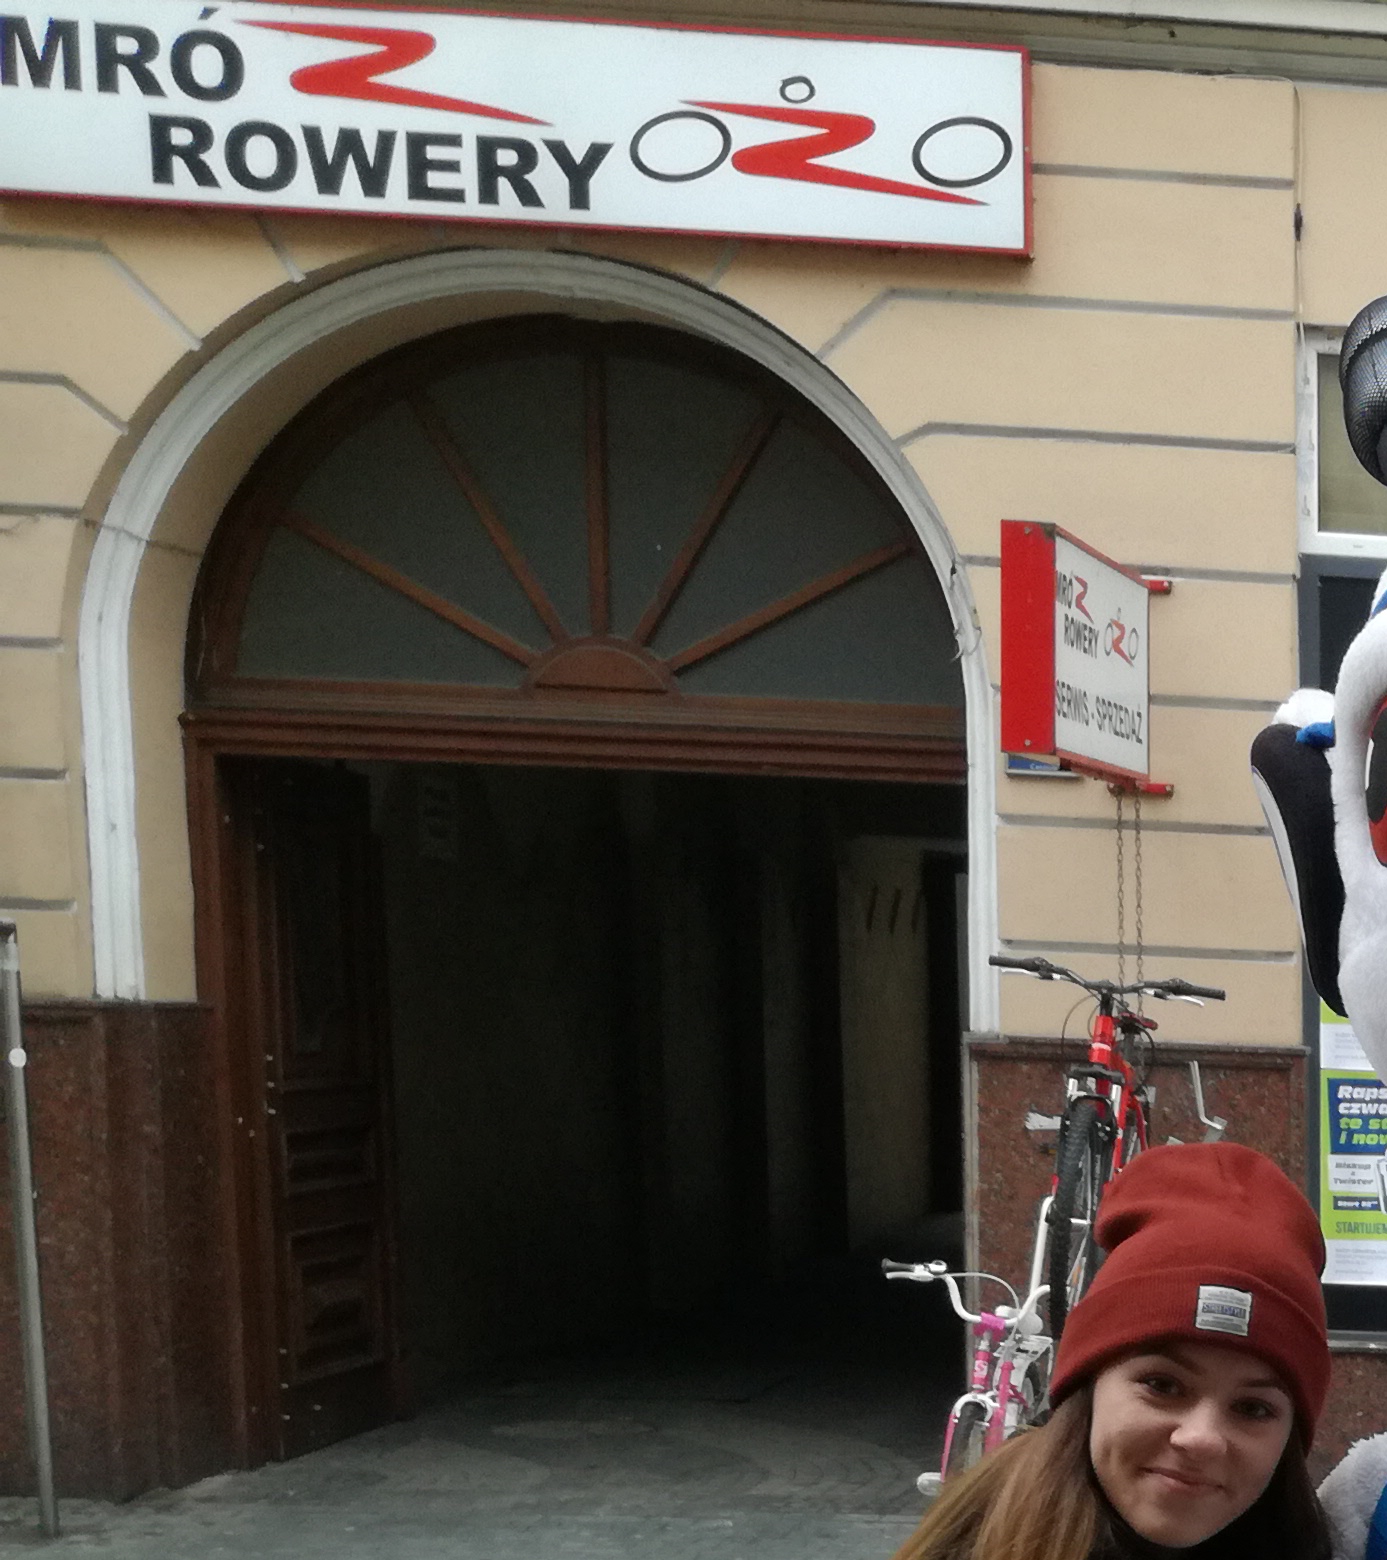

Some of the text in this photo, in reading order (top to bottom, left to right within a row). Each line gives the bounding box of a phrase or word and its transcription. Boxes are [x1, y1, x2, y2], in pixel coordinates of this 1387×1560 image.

[149, 114, 614, 211] ROWERY
[1064, 613, 1100, 658] ROWERY
[1339, 1117, 1363, 1130] te
[1339, 1131, 1347, 1144] i
